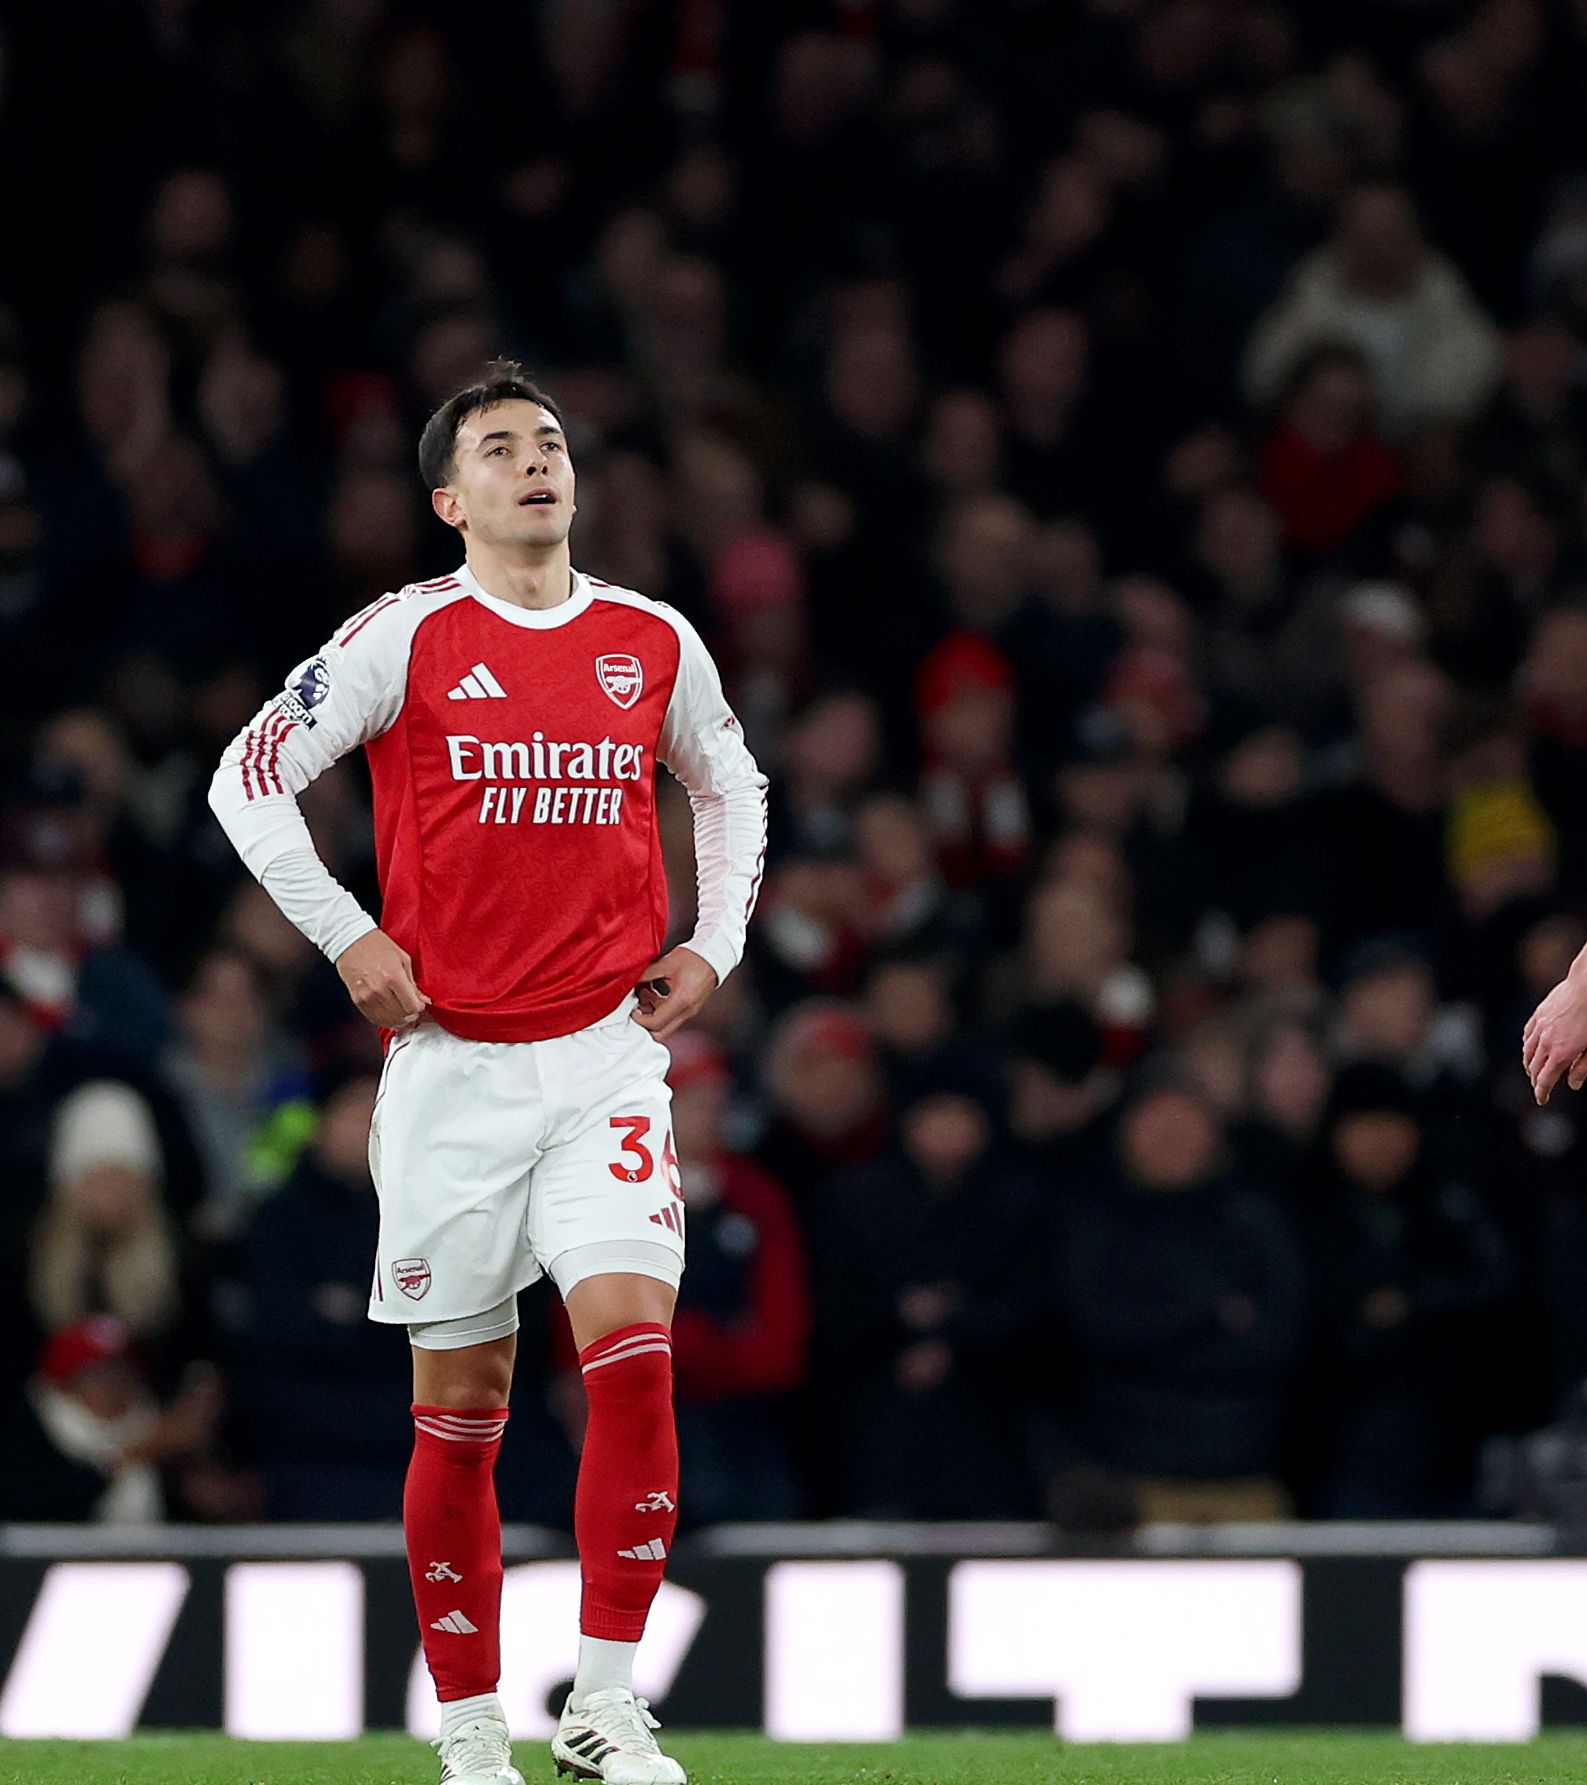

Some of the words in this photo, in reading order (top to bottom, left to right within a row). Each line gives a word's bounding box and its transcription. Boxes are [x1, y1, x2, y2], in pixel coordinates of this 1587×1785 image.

[603, 663, 636, 673] Arsenal
[445, 731, 644, 781] Emirates
[478, 787, 527, 824] FLY
[532, 787, 622, 825] BETTER
[608, 1115, 684, 1201] 36
[397, 1264, 425, 1273] Arsenal
